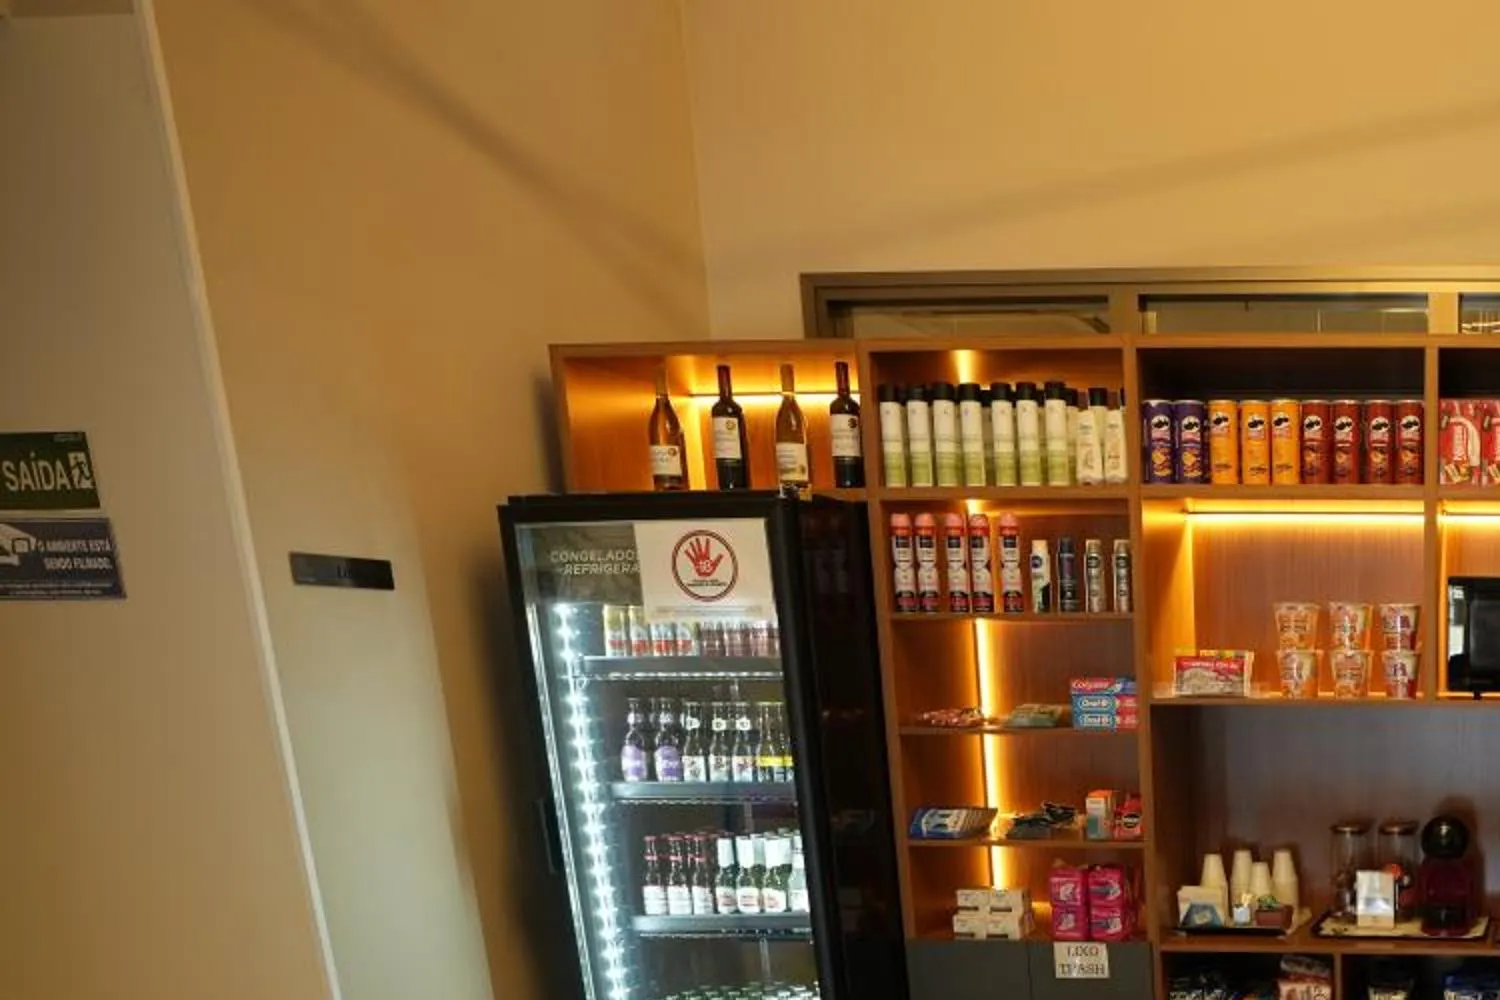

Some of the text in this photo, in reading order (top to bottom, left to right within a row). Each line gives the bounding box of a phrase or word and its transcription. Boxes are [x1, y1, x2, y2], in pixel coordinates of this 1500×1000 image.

[2, 450, 71, 492] SAÍDA
[551, 549, 637, 563] CONGELADO
[1066, 945, 1099, 957] LIXO
